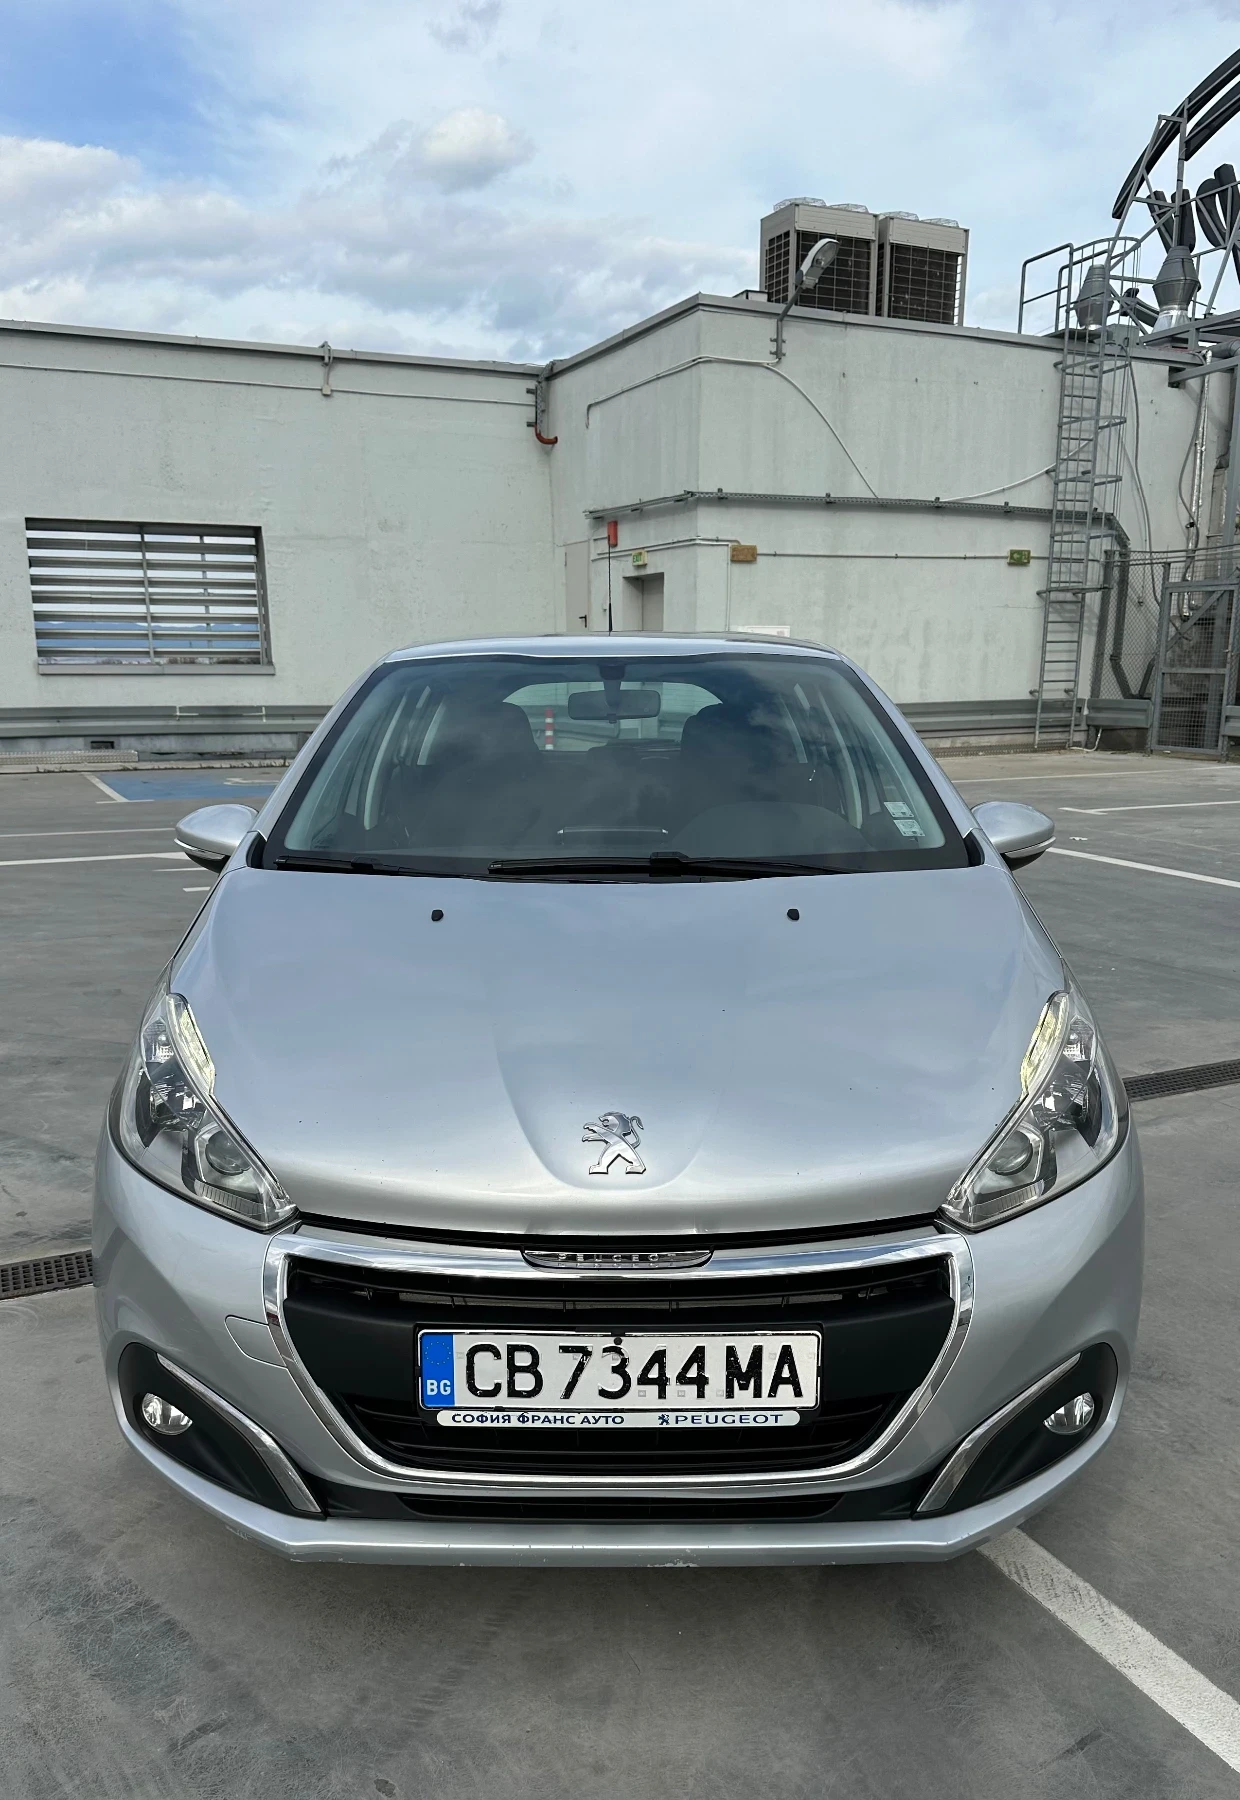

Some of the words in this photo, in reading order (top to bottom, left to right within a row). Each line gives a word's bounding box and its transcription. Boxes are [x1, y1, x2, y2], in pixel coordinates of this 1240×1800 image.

[466, 1343, 543, 1398] CB
[559, 1344, 709, 1399] 7344
[725, 1344, 803, 1399] MA
[426, 1380, 451, 1395] BG
[451, 1413, 511, 1424] СОФИЯ
[517, 1412, 576, 1424] ФРАНС
[580, 1415, 625, 1425] АУТО
[675, 1414, 783, 1424] PEUGEOT
